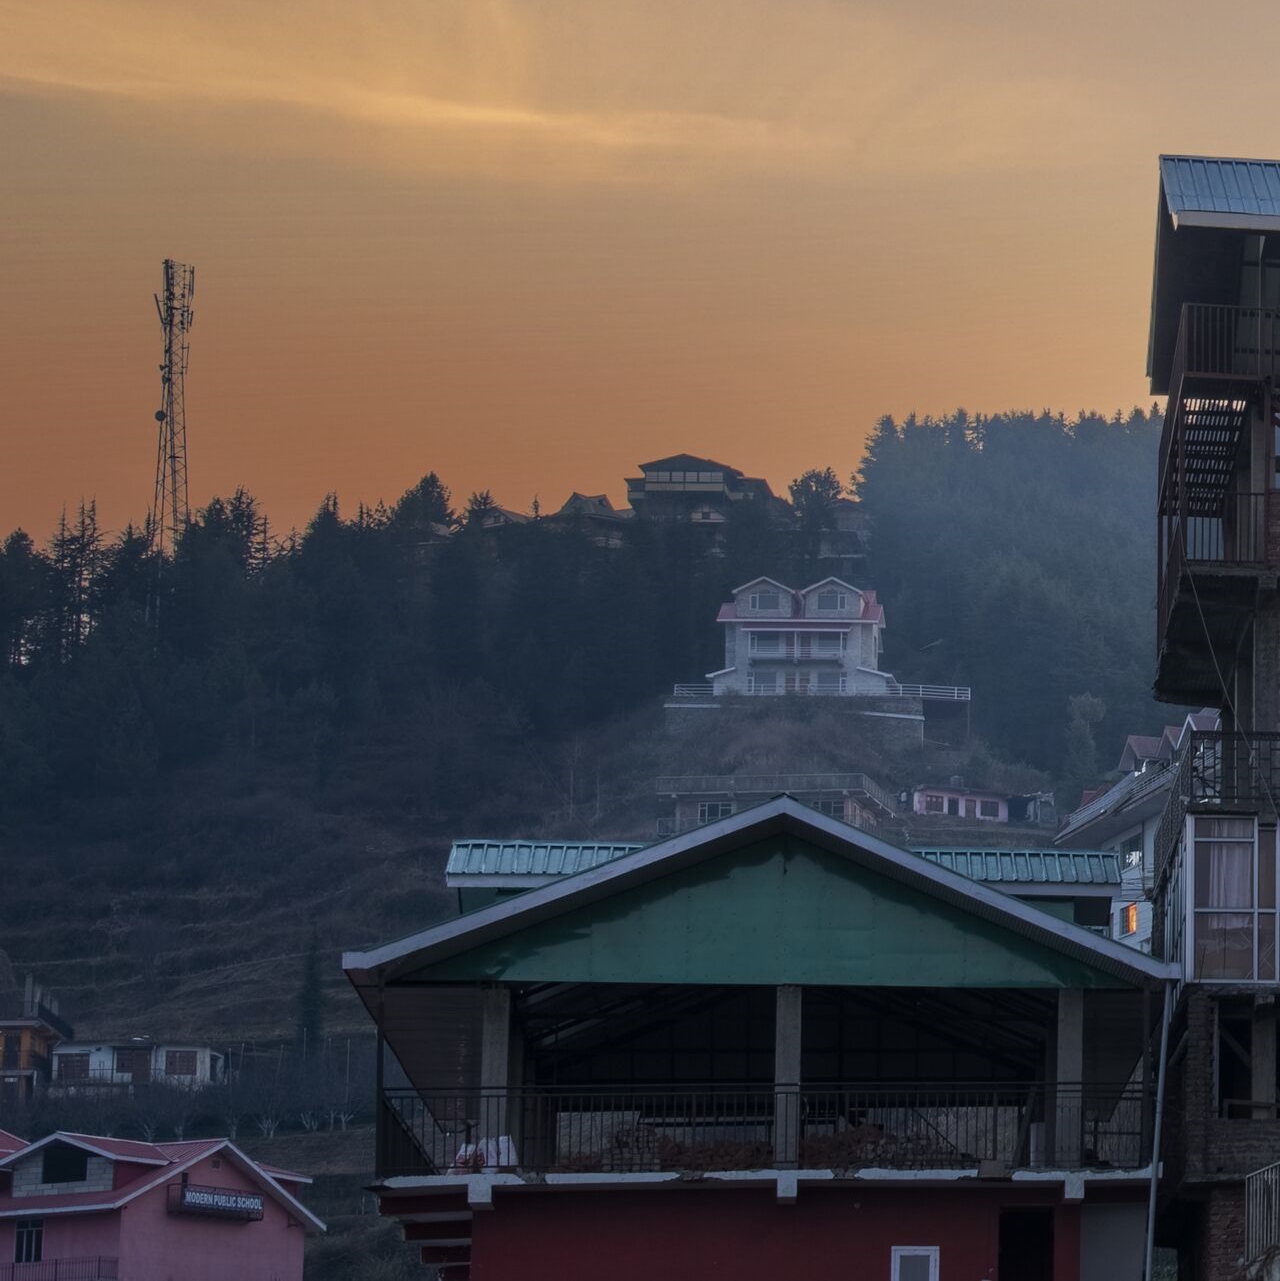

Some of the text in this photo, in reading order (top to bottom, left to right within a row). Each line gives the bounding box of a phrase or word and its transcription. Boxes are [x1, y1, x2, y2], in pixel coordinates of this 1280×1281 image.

[186, 1191, 262, 1209] MODERN PUBLIC SCHOOL
